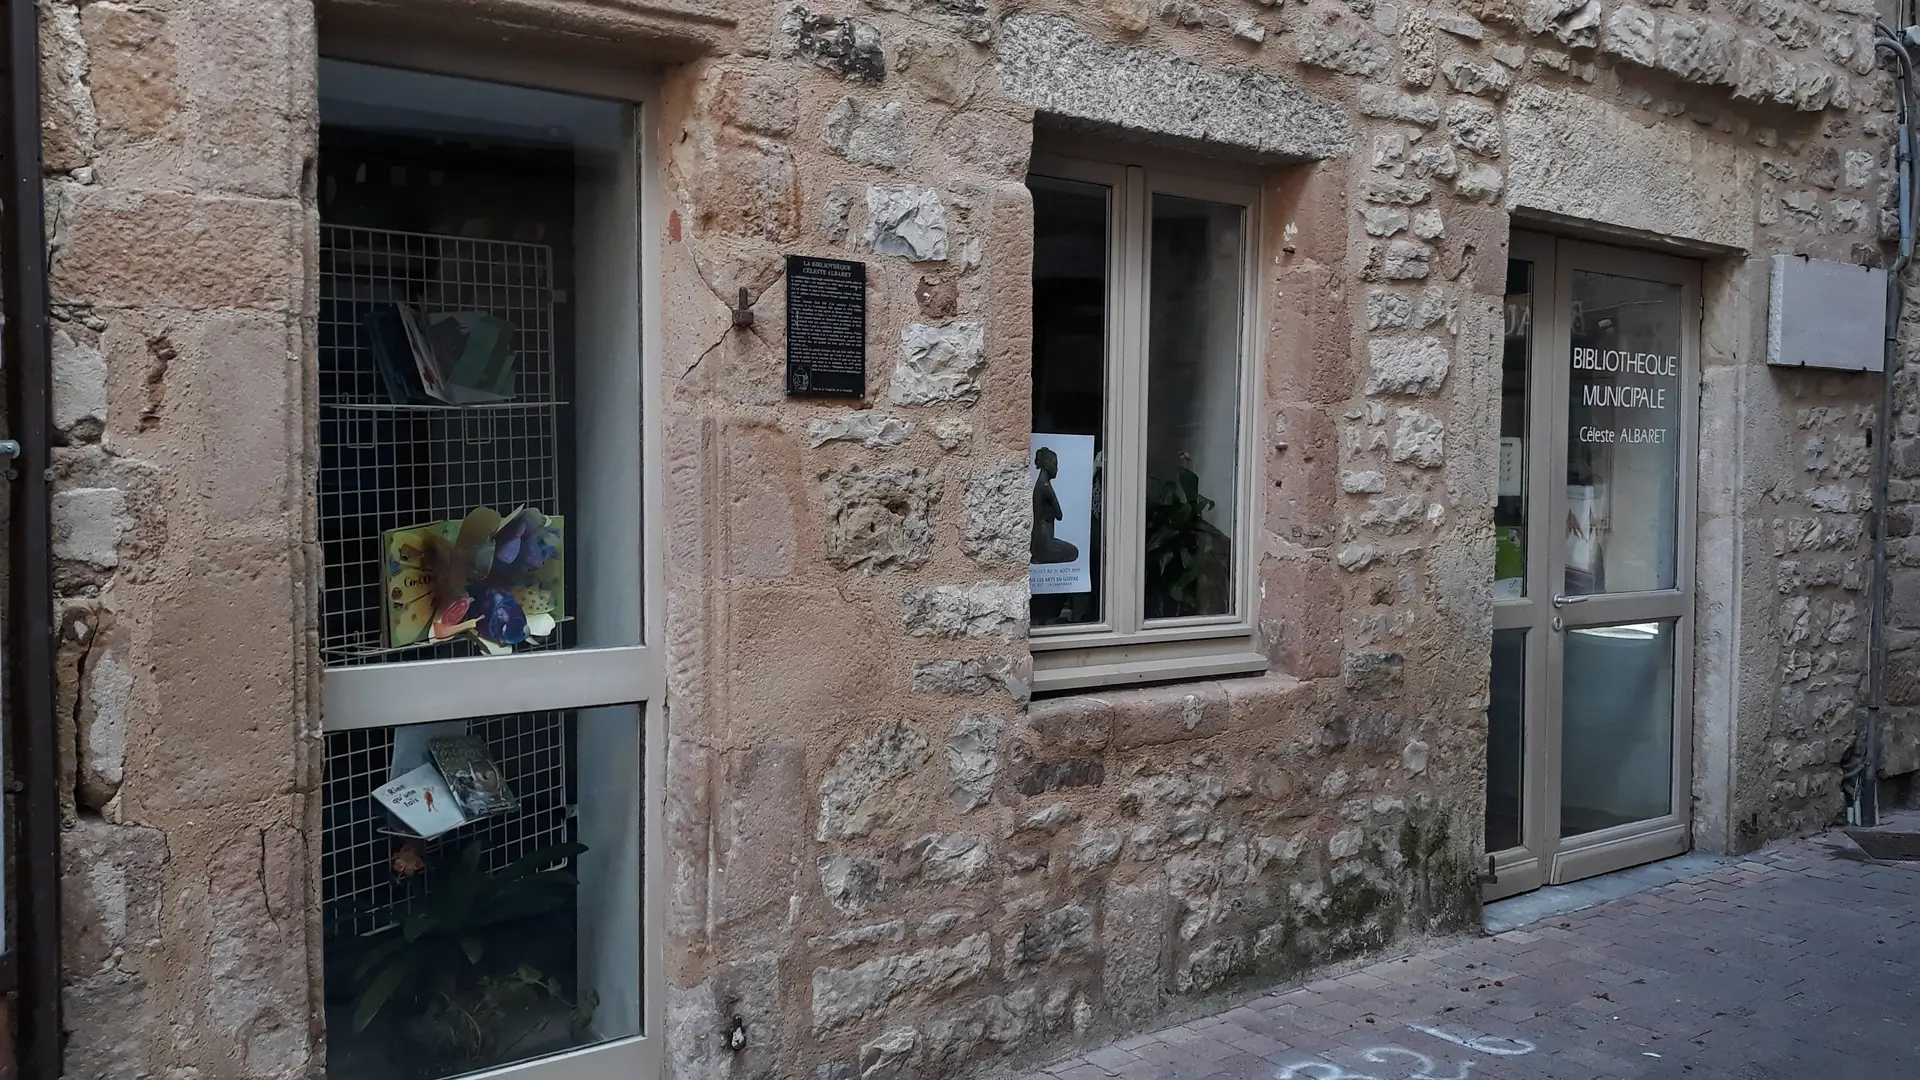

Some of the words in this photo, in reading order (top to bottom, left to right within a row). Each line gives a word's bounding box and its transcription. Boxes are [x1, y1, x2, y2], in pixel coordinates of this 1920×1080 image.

[827, 270, 852, 278] ALBARET
[1573, 346, 1677, 377] BIBLIOTHEQUE
[1582, 384, 1667, 409] MUNICIPALE
[1579, 426, 1615, 444] Céleste
[1619, 428, 1668, 444] ALBARET
[387, 785, 406, 796] Rien
[403, 798, 420, 808] fois
